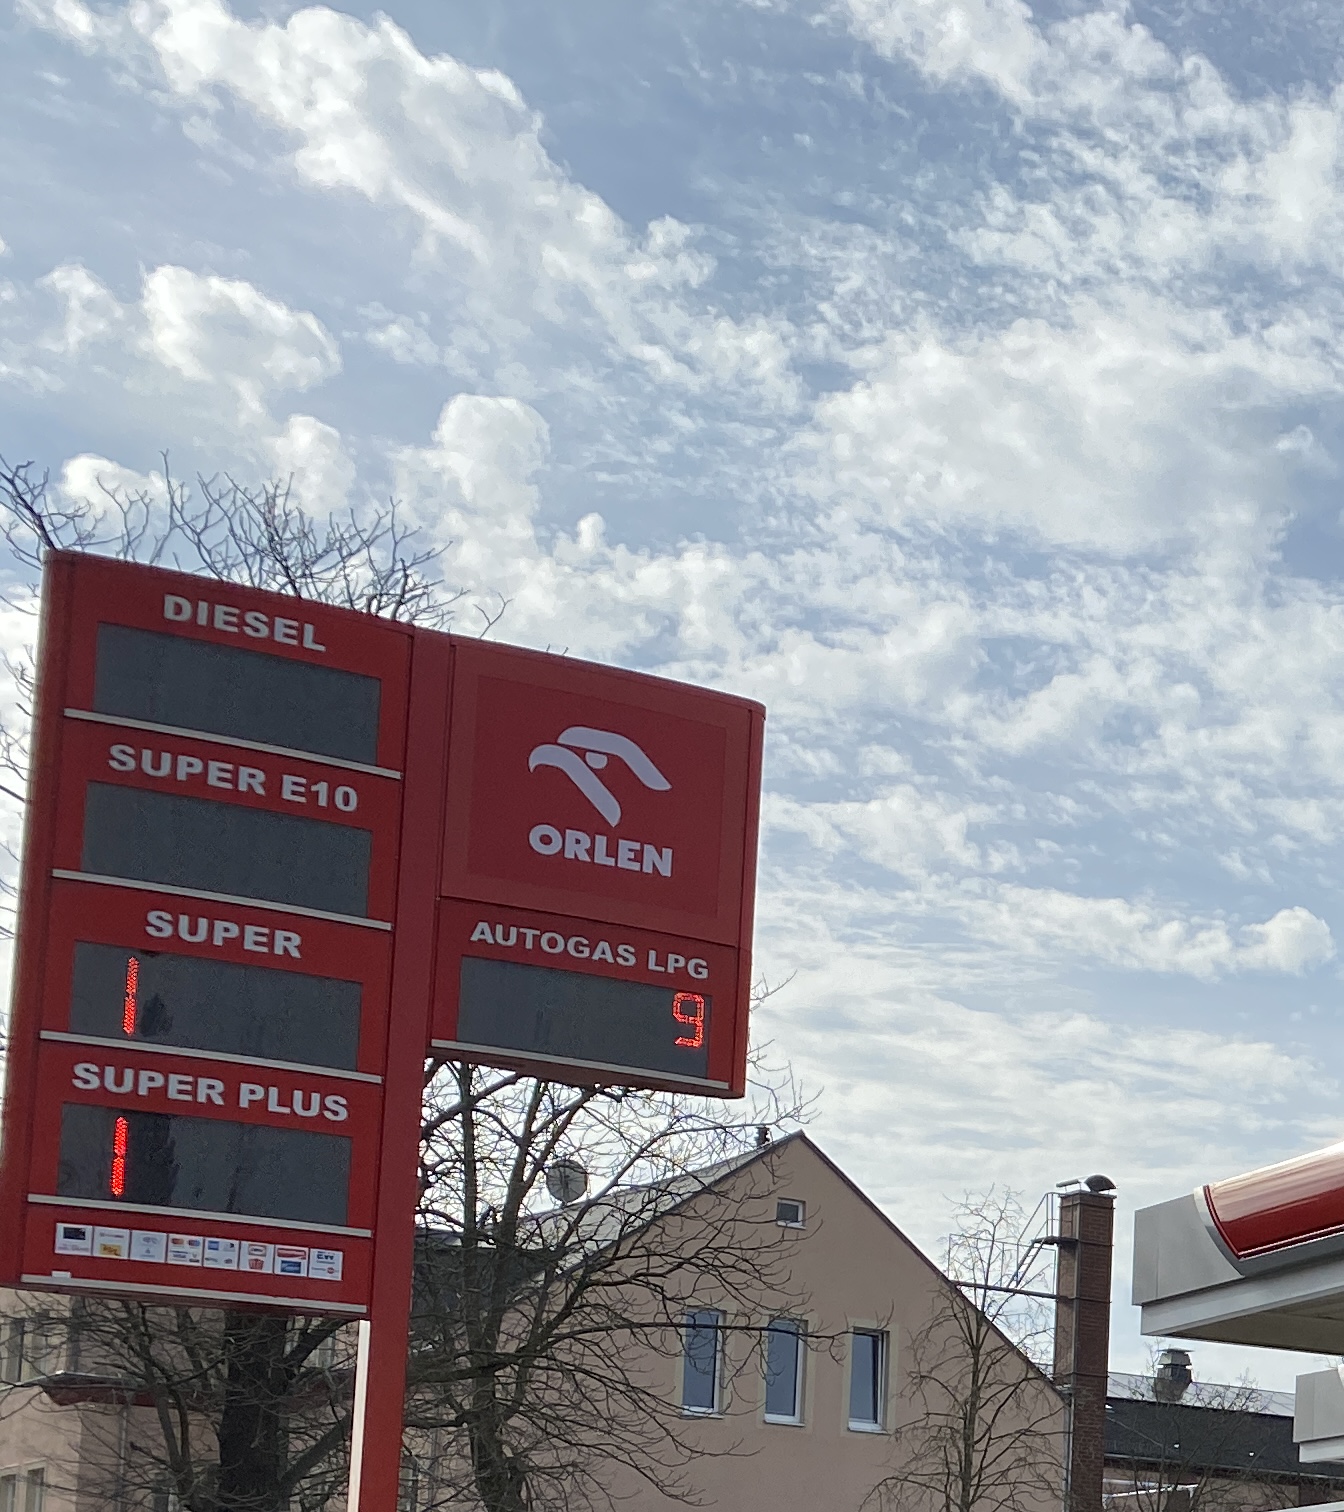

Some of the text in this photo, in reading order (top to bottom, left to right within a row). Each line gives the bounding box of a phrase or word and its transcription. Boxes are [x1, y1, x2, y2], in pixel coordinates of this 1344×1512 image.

[163, 594, 326, 652] DIESEL
[108, 744, 358, 812] SUPER E10
[528, 824, 673, 877] ORLEN
[145, 910, 302, 958] SUPER
[470, 921, 709, 979] AUTOGAS LPG
[672, 992, 704, 1048] 9
[72, 1063, 348, 1122] SUPER PLUS
